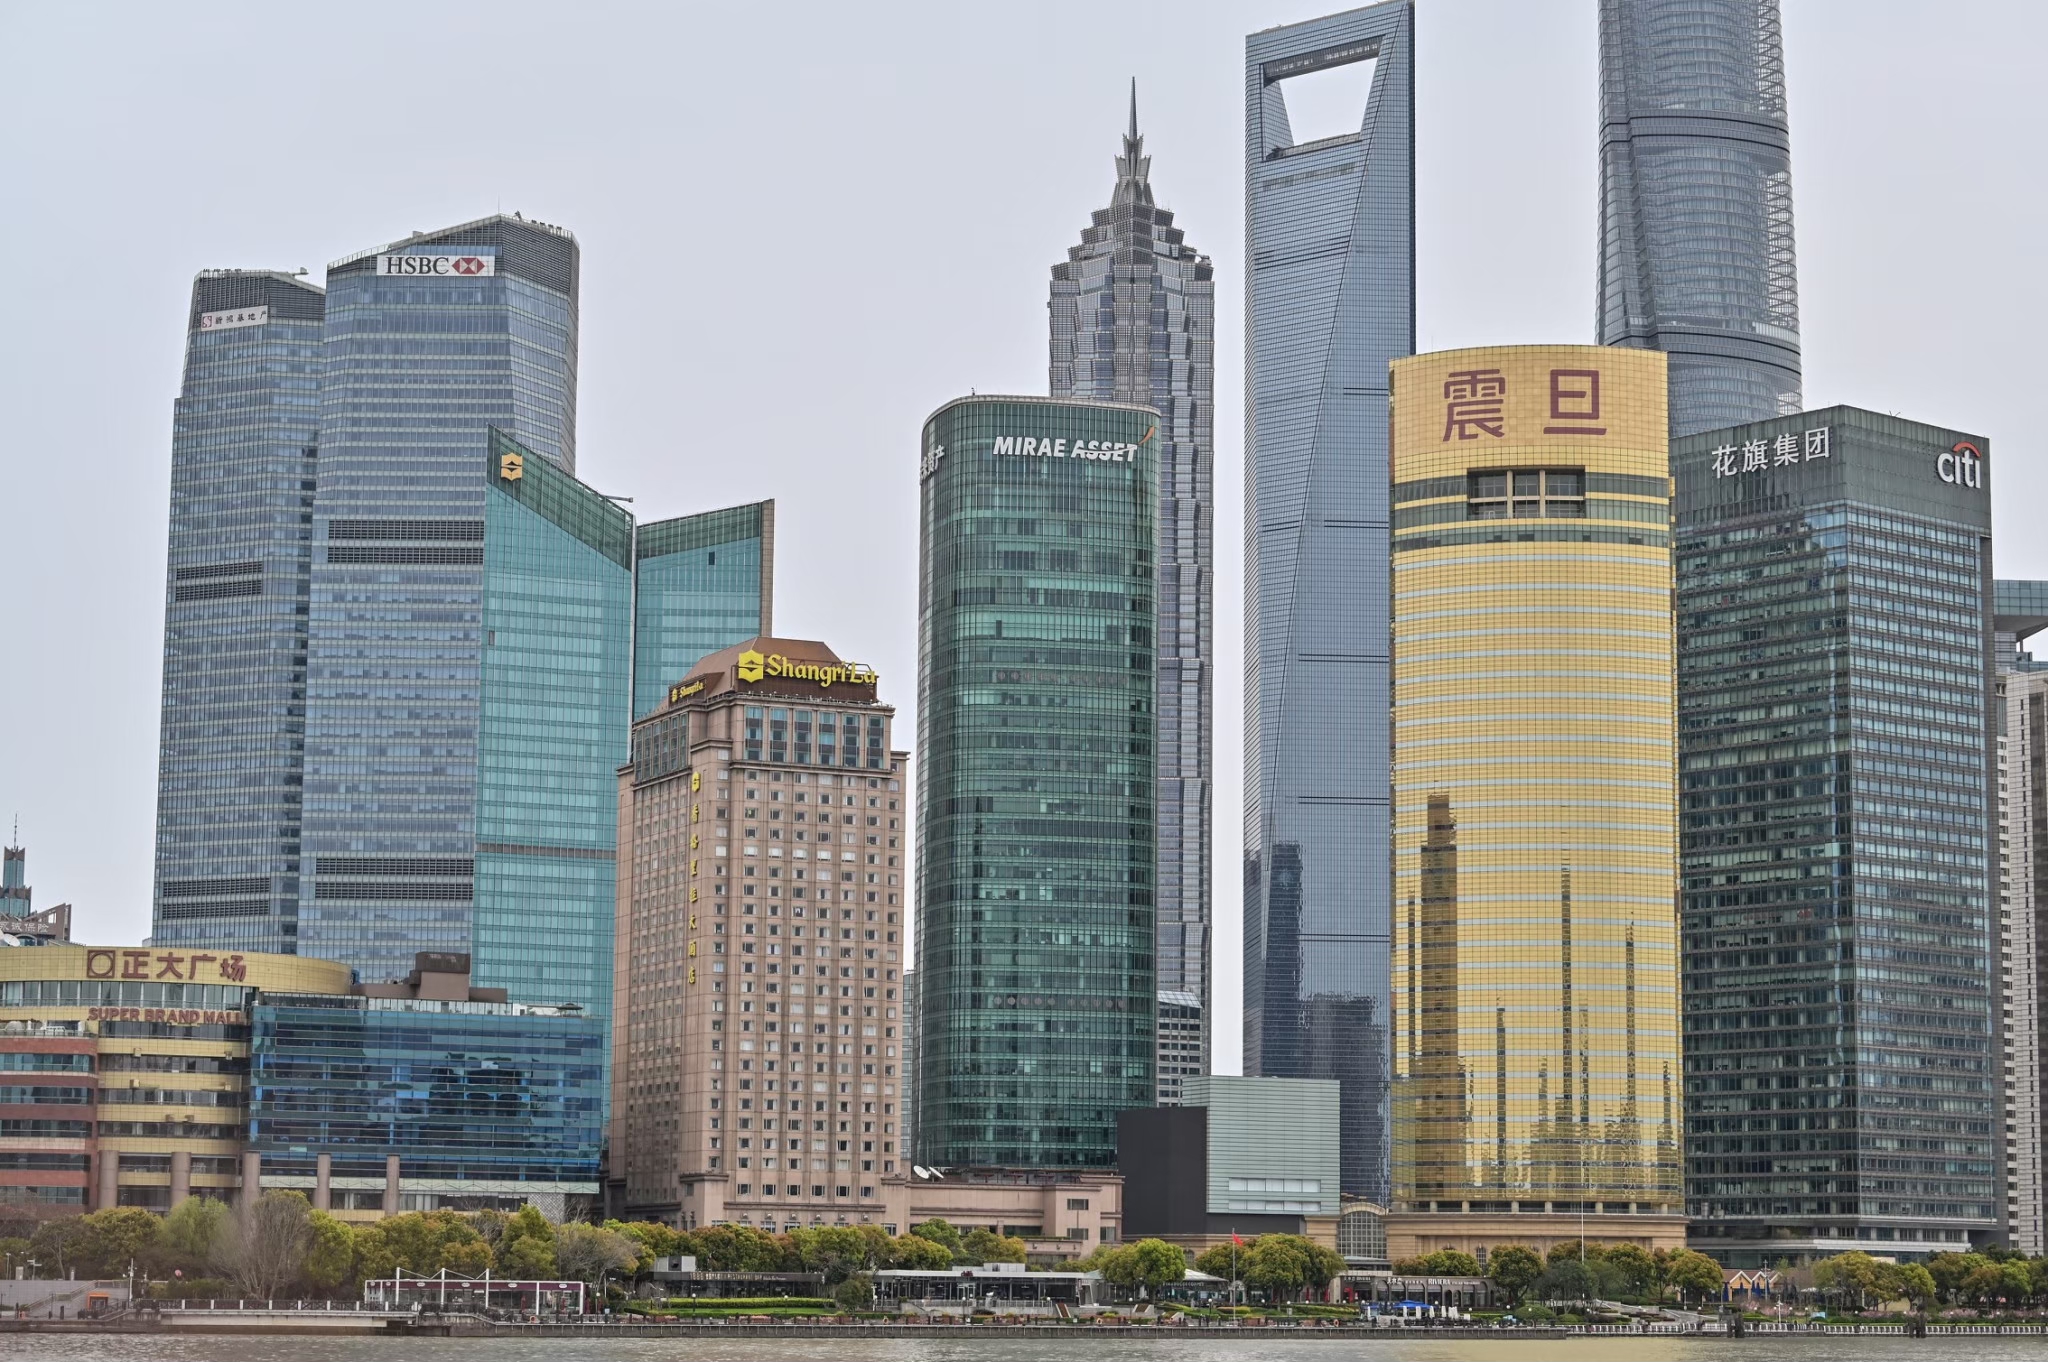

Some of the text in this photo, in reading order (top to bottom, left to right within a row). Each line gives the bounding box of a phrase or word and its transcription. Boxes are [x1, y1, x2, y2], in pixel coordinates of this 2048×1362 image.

[386, 256, 449, 275] HSBC
[1442, 368, 1608, 442] 震旦
[992, 436, 1138, 462] MIRAE ASSET
[1711, 426, 1831, 479] 花旗集团
[1937, 449, 1982, 489] citi
[766, 653, 877, 688] Shangri-La
[121, 951, 247, 982] 正大广场
[88, 1007, 246, 1025] SUPER BRAND MALL
